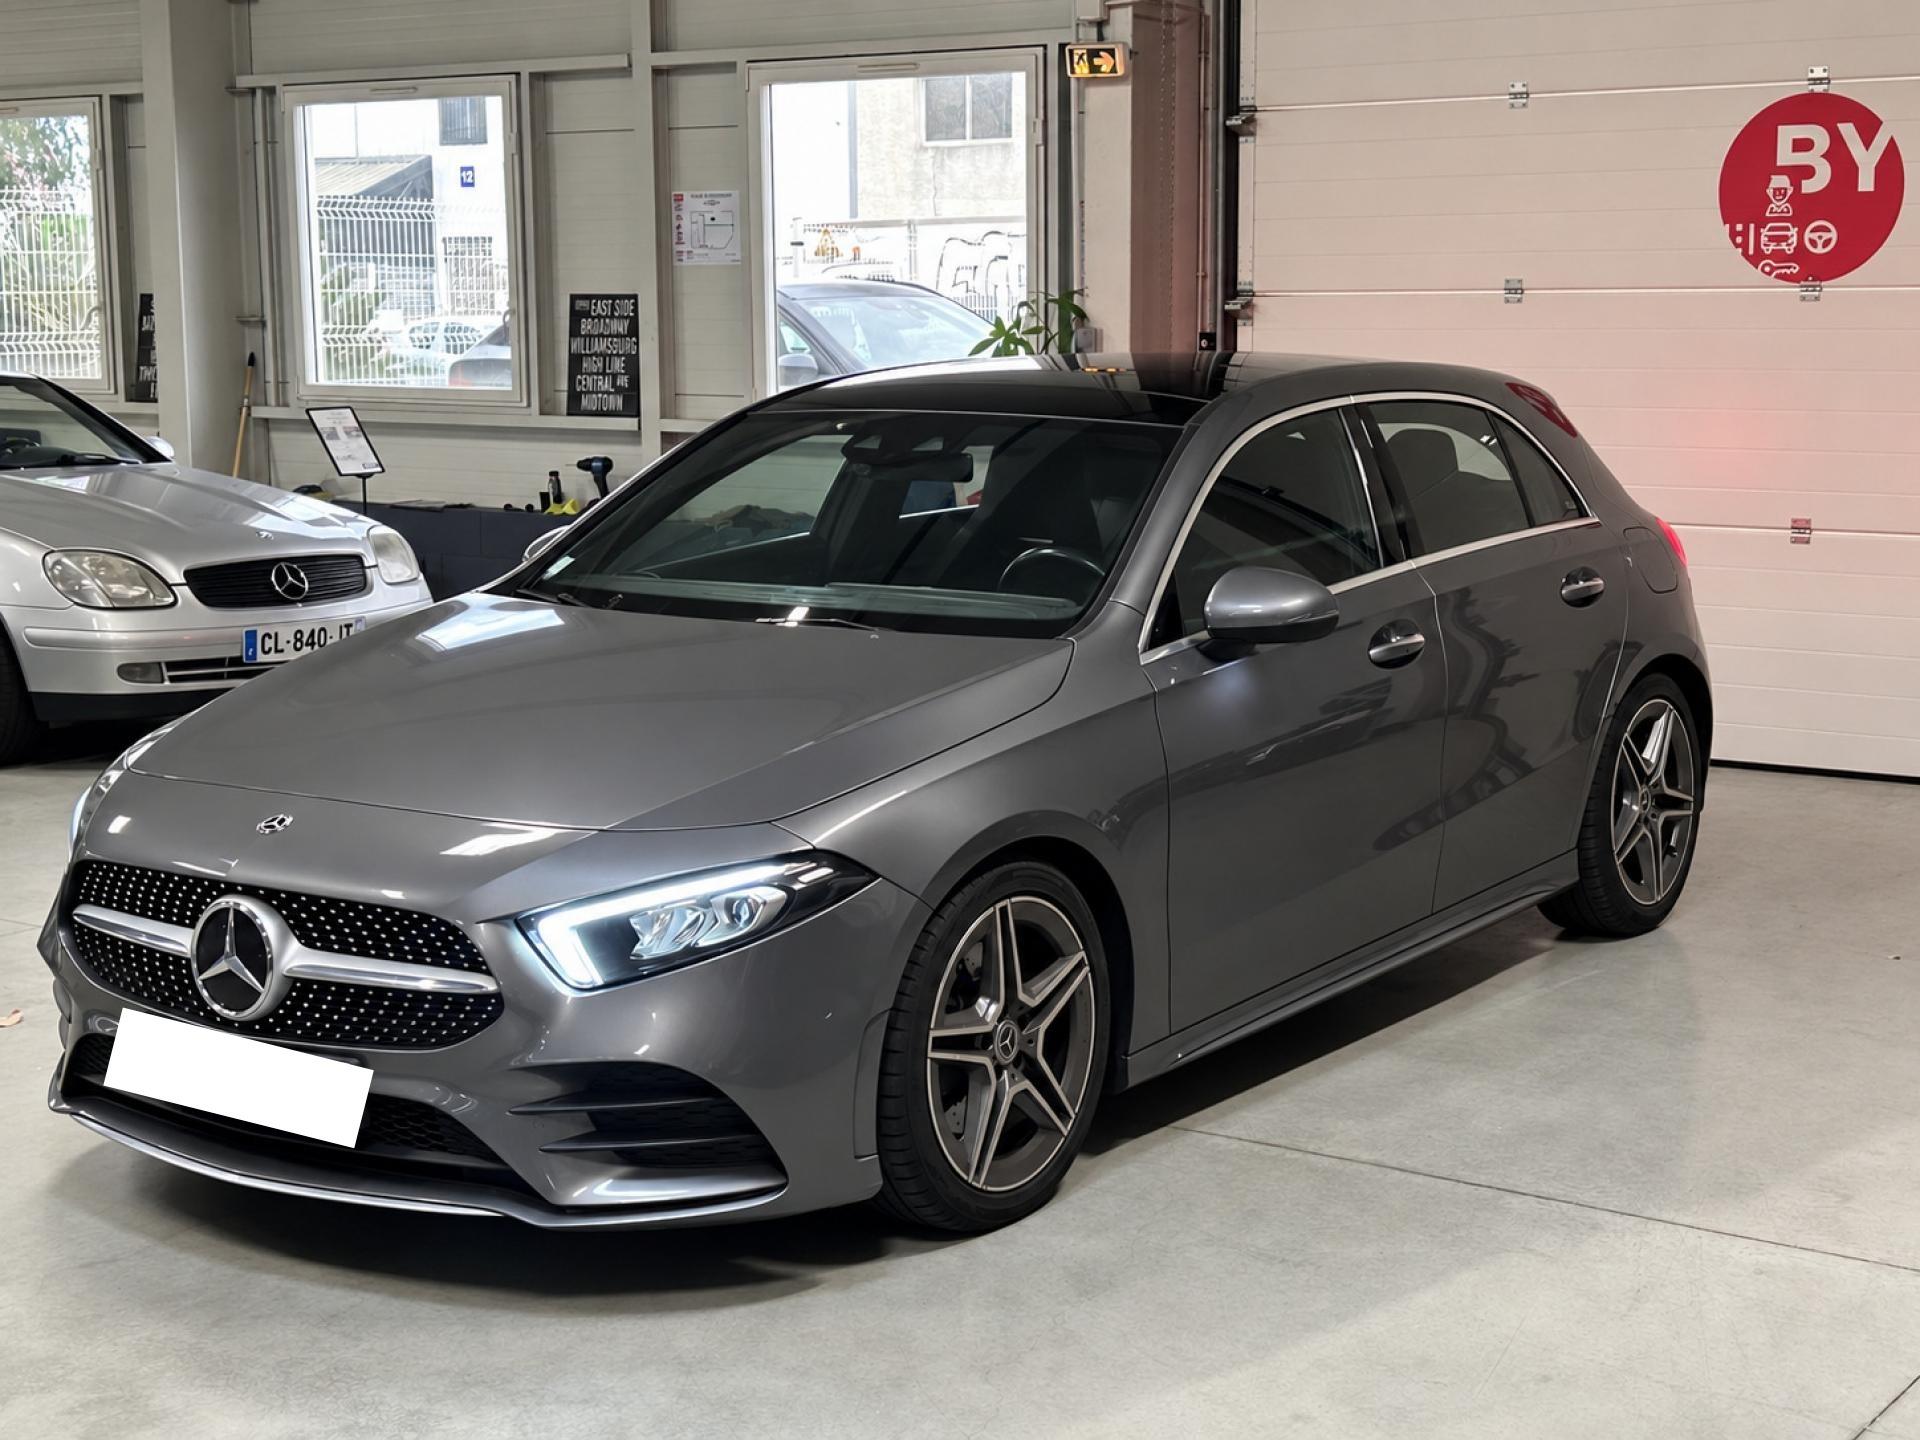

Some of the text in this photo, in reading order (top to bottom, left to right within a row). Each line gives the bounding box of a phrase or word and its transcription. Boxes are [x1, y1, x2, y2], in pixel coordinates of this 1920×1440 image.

[1776, 122, 1893, 194] BY
[590, 299, 611, 316] EAST
[613, 299, 635, 316] SIDE
[580, 318, 630, 335] BROADWAY
[570, 337, 637, 354] WILLIAMSBURG
[576, 374, 615, 391] CENTRAL
[580, 393, 623, 411] MIDTOWN
